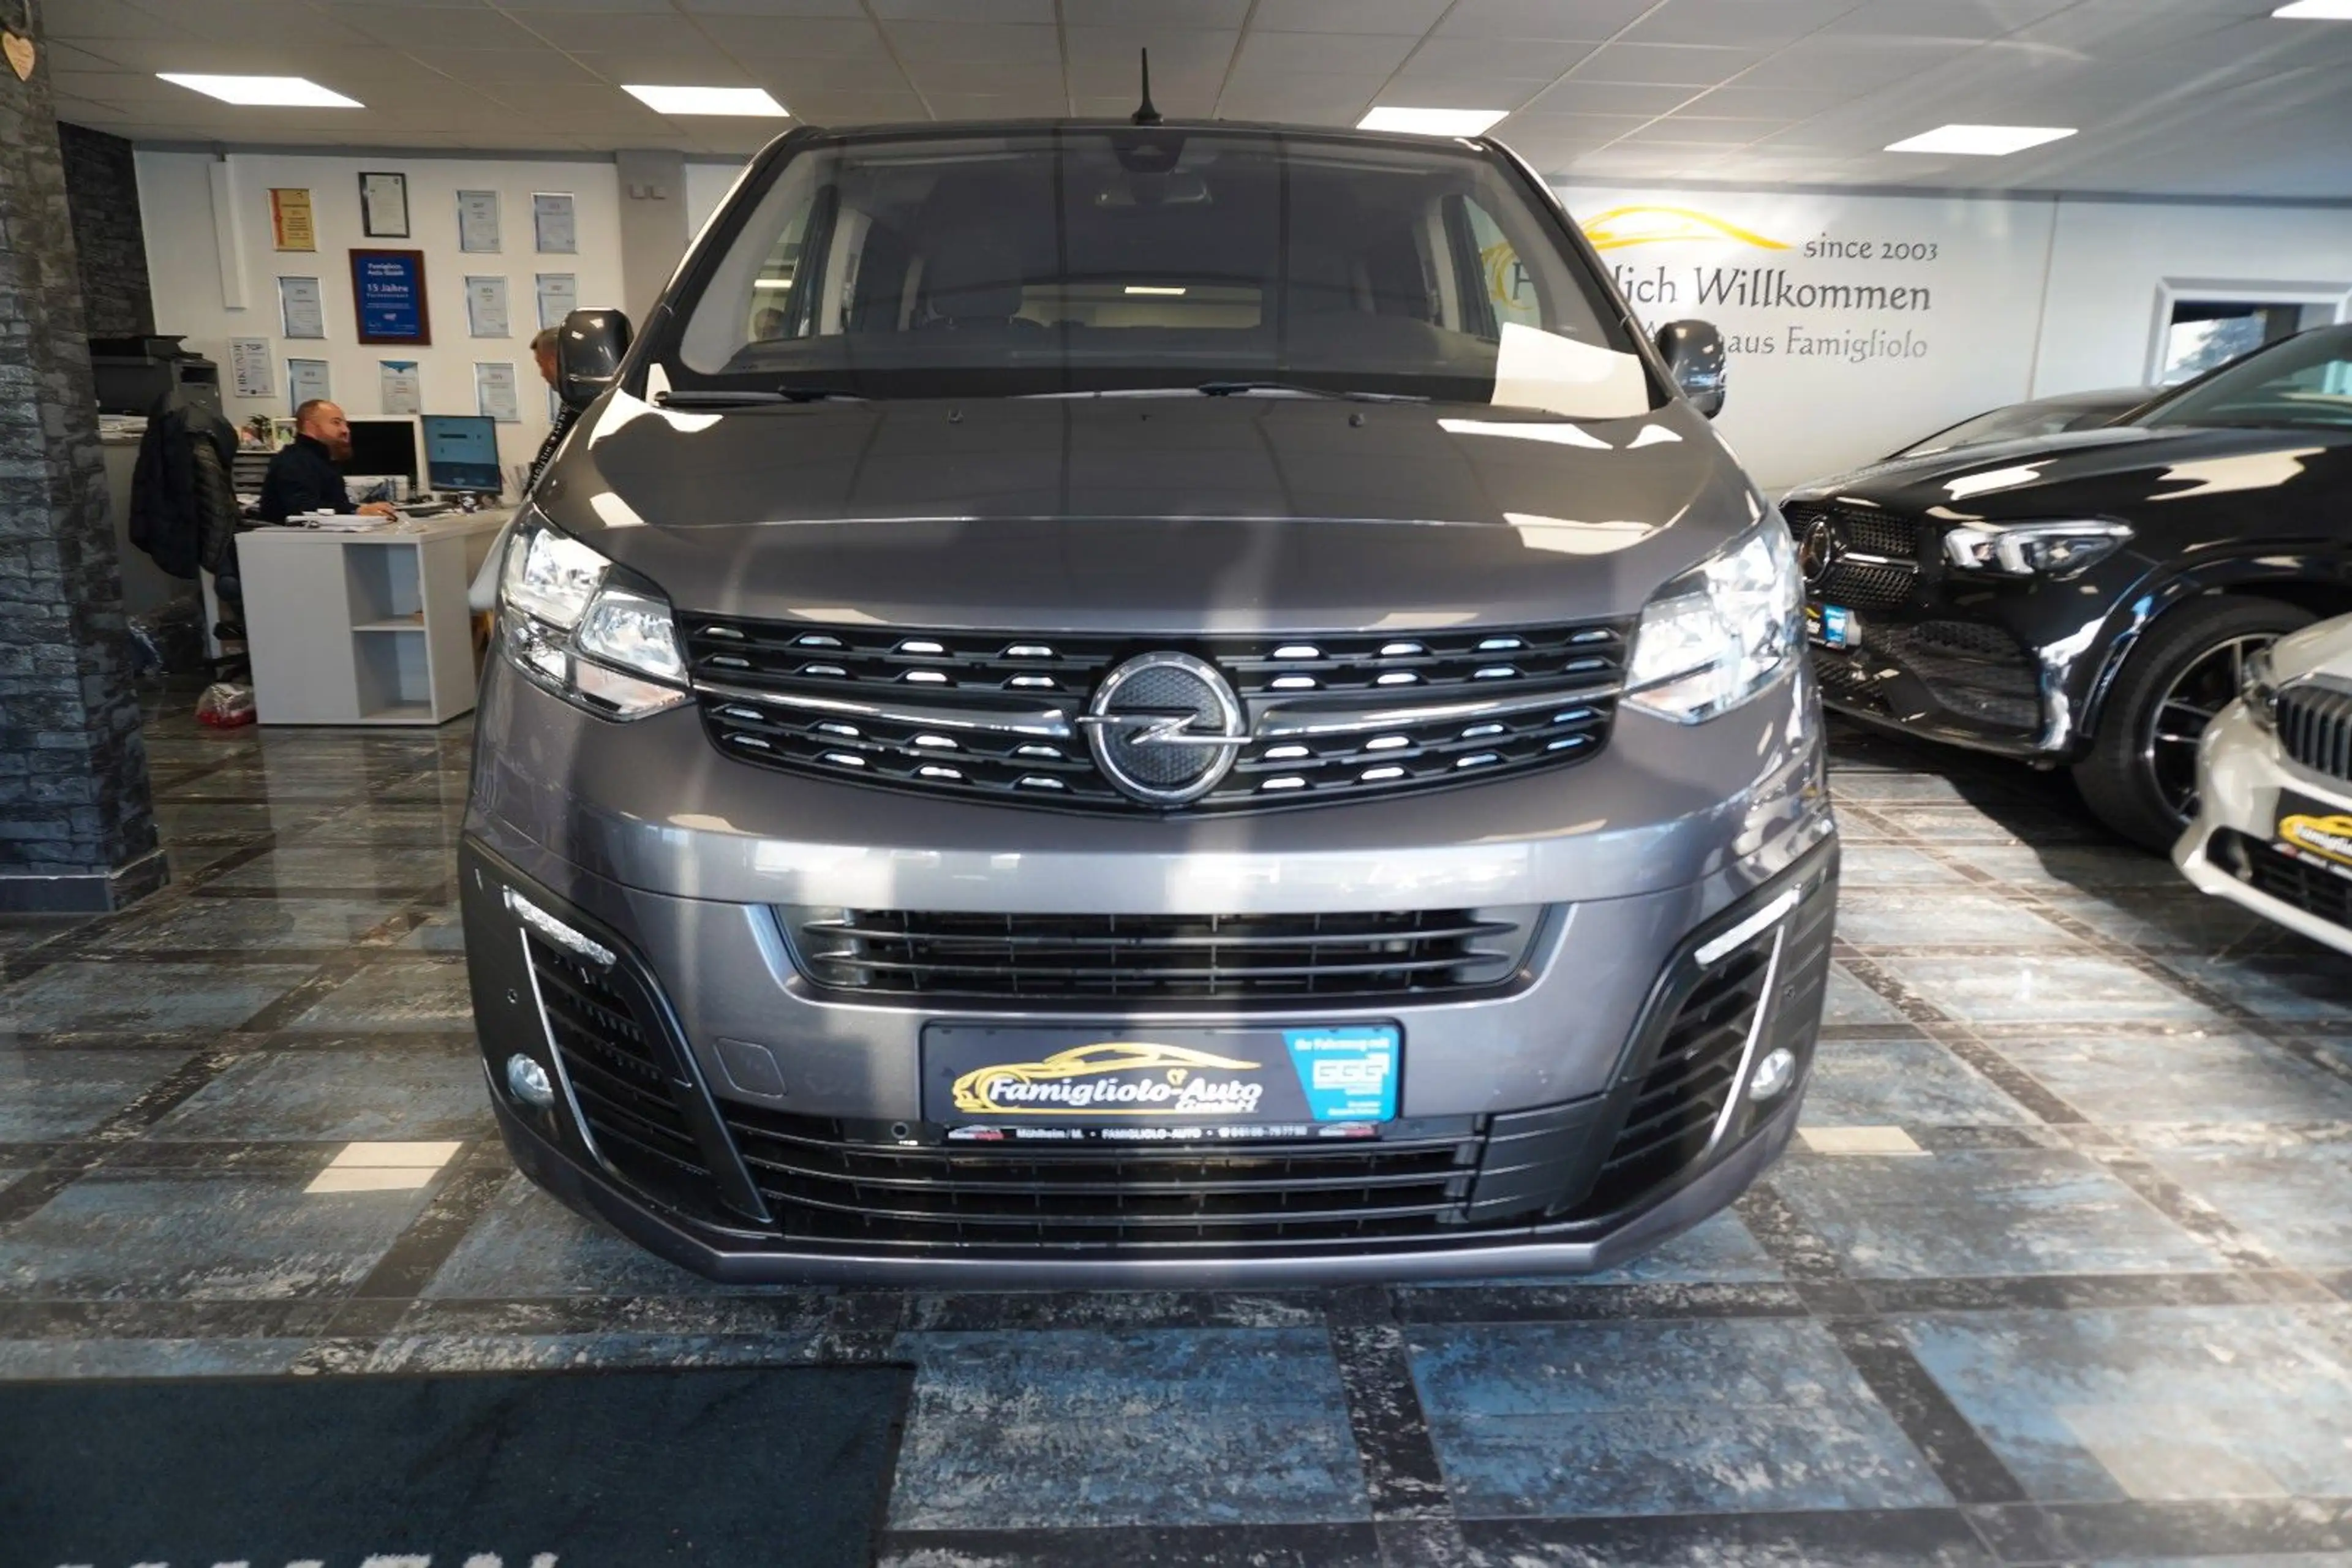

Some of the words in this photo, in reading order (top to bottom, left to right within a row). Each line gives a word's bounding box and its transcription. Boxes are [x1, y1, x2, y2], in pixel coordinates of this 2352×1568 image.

[1804, 233, 1872, 258] since
[1880, 243, 1938, 261] 2003
[1694, 267, 1931, 311] Willkommen
[1786, 325, 1928, 363] Famigliolo
[989, 1077, 1264, 1106] Famigliolo-Auto
